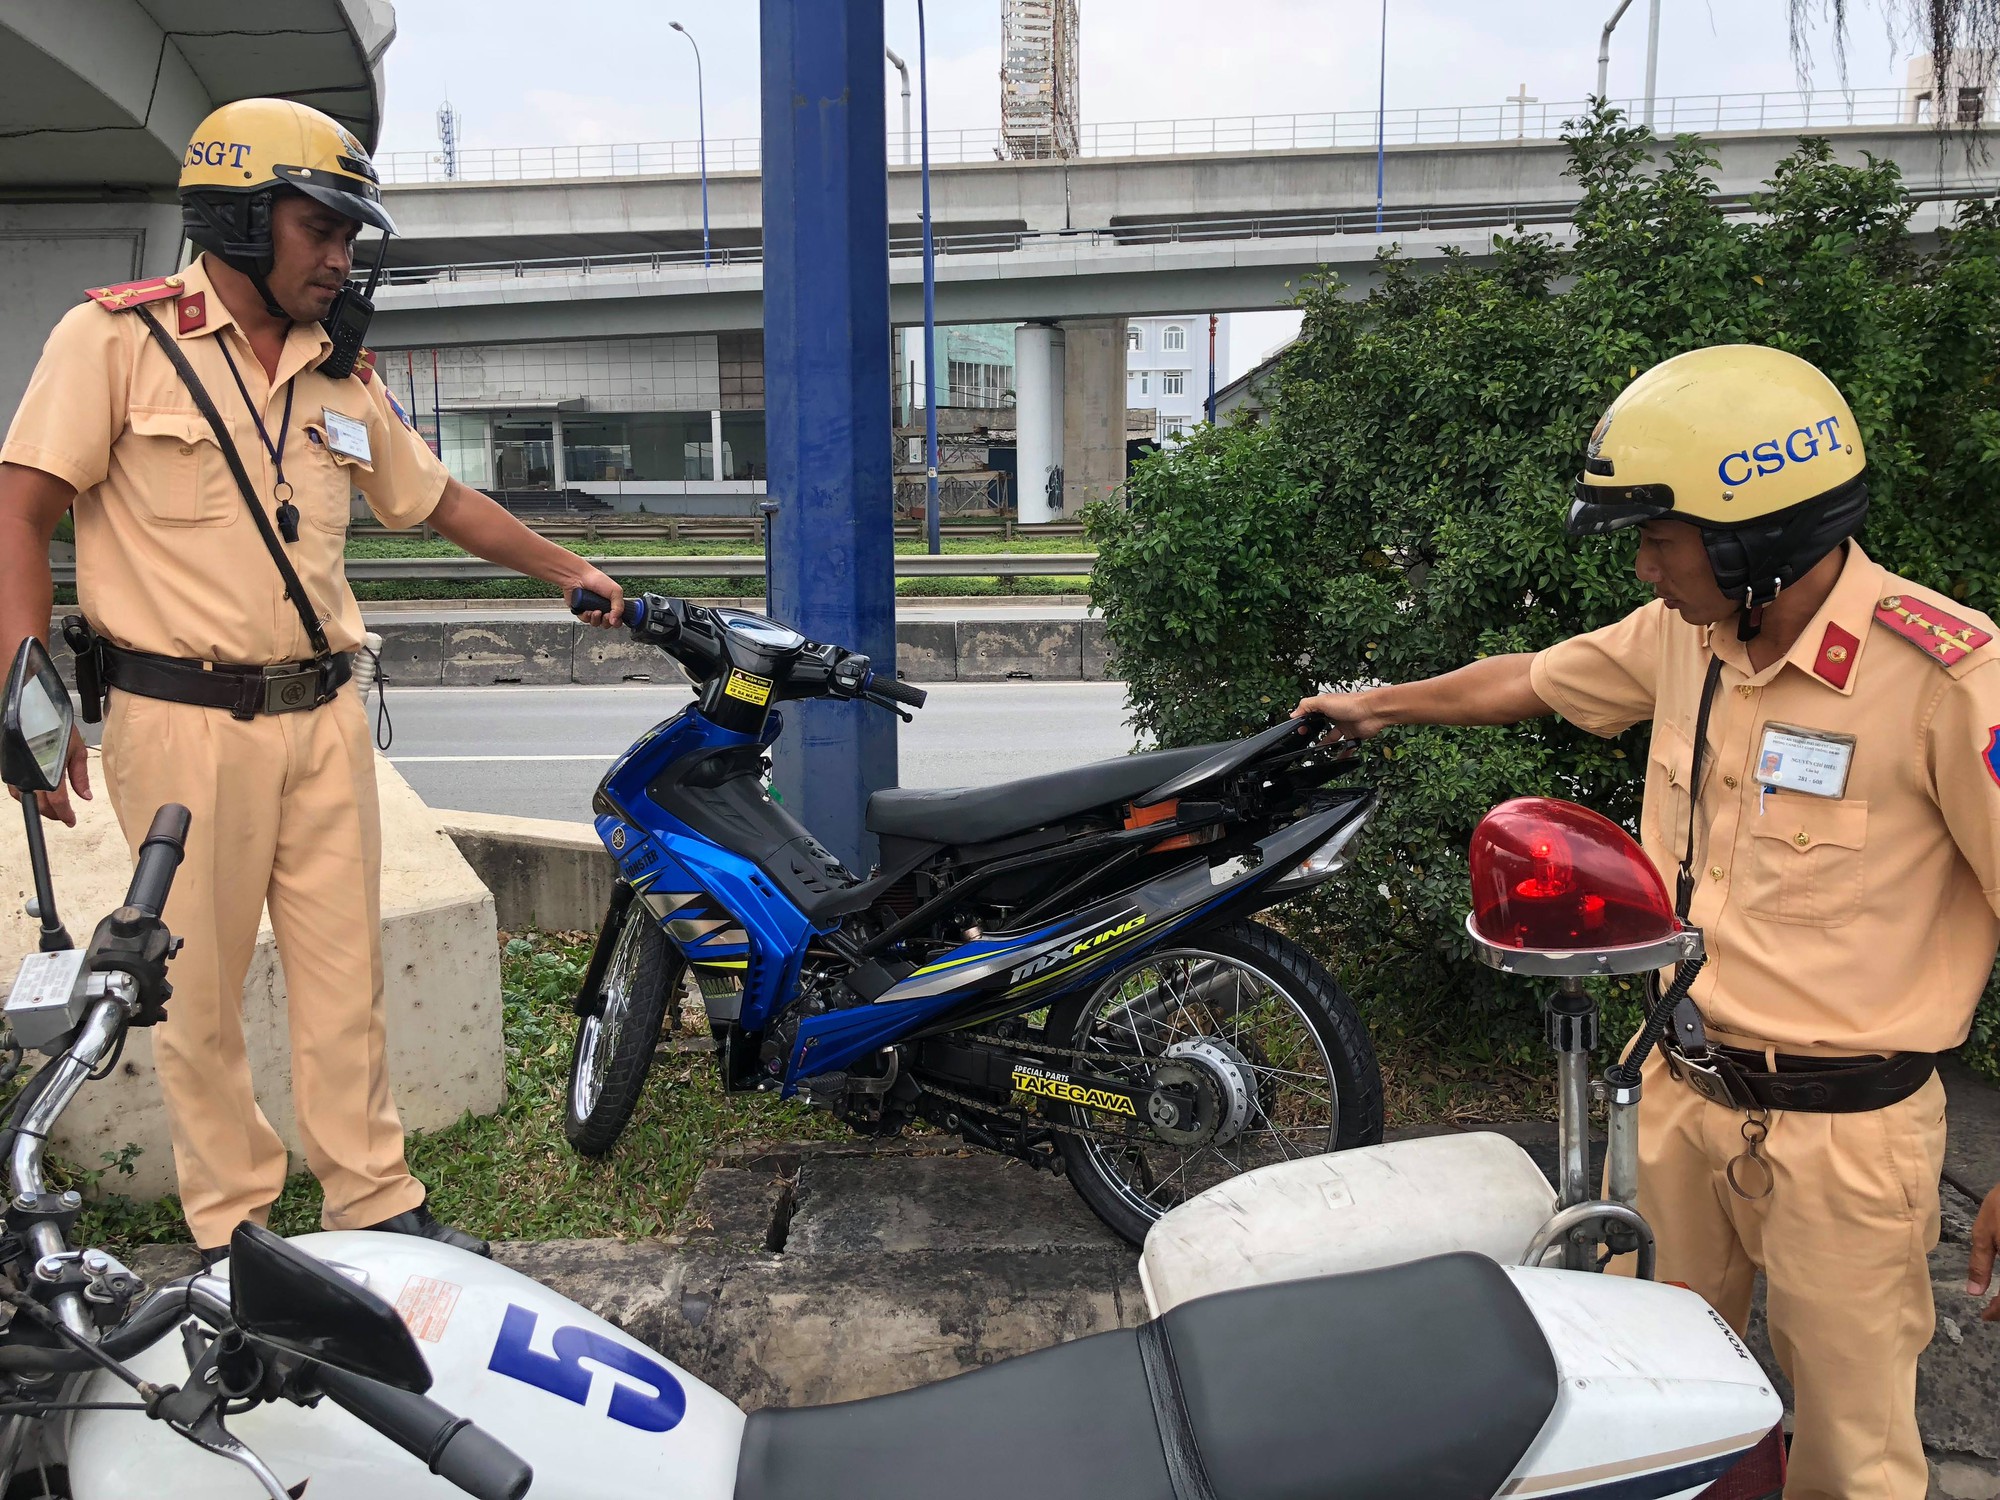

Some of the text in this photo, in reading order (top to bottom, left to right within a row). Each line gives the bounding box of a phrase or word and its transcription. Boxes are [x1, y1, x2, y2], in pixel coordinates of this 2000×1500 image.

[182, 141, 251, 168] CSGT
[1718, 415, 1842, 486] CSGT
[699, 975, 745, 995] AMAHA
[1011, 1071, 1137, 1116] TAKEGAWA
[1014, 1064, 1070, 1083] SPECIAL PARTS
[1707, 1310, 1750, 1361] HONDA
[487, 1302, 687, 1433] 5
